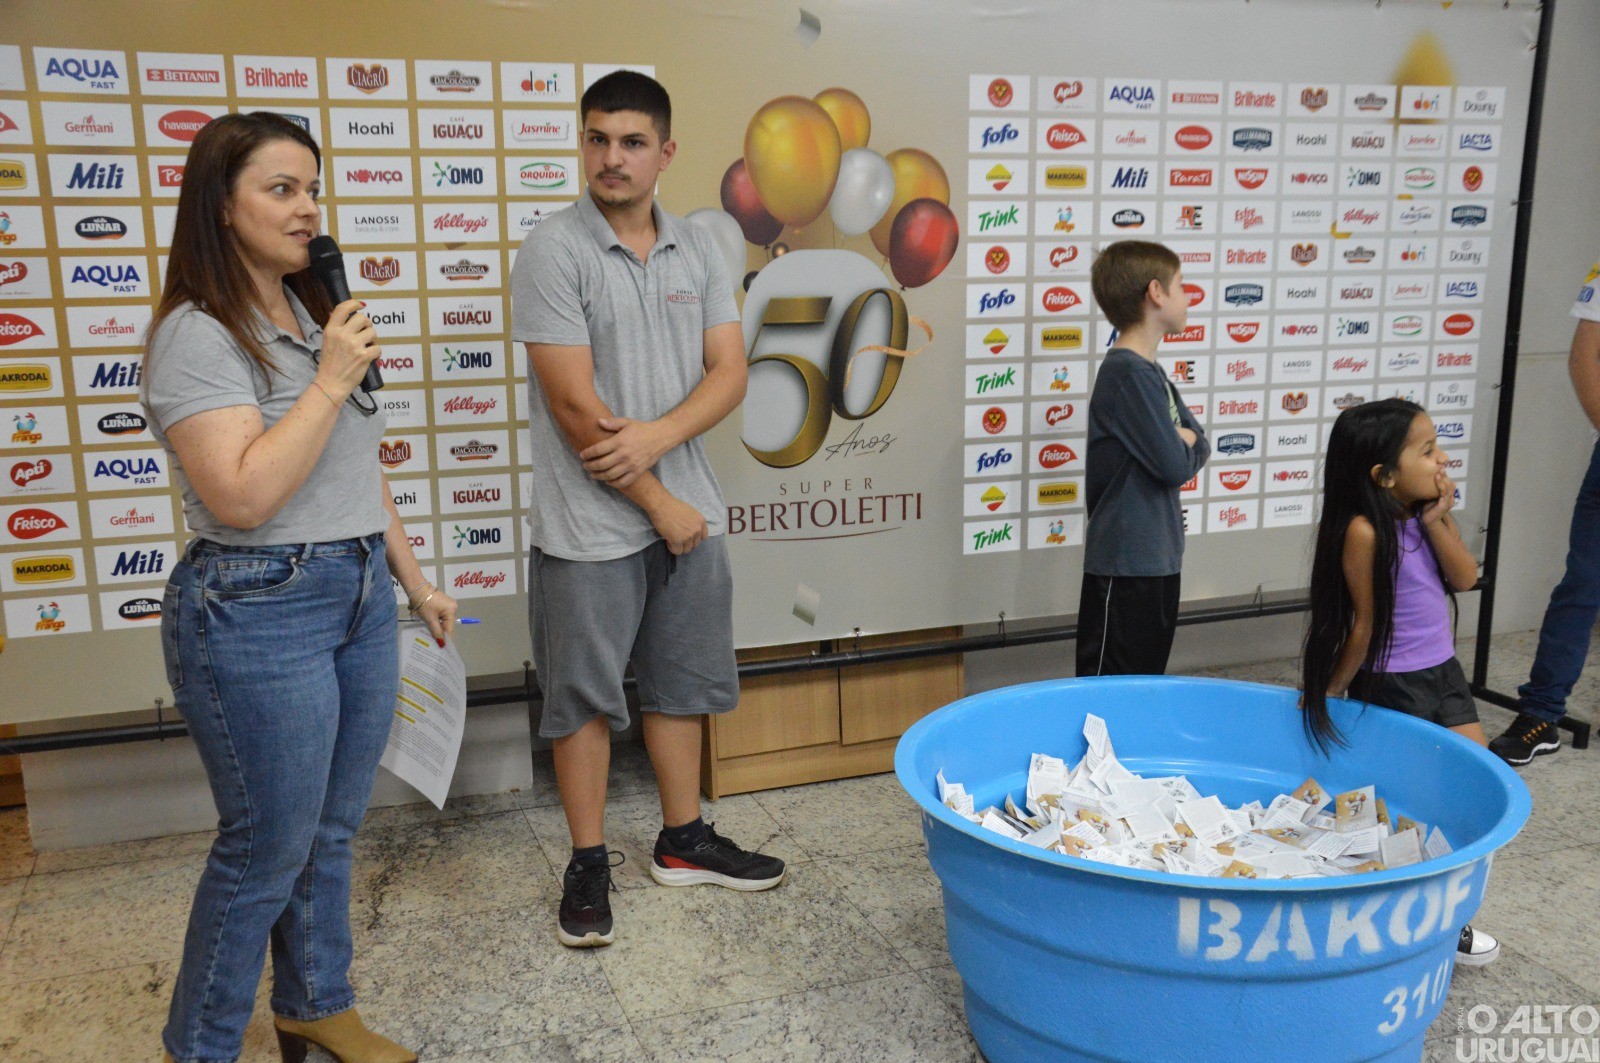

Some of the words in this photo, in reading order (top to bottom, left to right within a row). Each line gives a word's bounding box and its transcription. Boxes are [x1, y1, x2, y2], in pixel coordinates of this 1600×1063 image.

[46, 57, 120, 81] AQUA
[163, 70, 216, 83] BETTANIN
[350, 67, 386, 87] CIAGRO
[244, 67, 308, 88] Brilhante
[521, 70, 558, 92] dori
[1110, 86, 1155, 103] AQUA
[1235, 91, 1276, 108] Brilhante
[65, 122, 114, 134] Germani
[348, 122, 394, 135] Hoahi
[518, 122, 561, 134] Jasmine
[982, 123, 1019, 149] fofo
[1296, 135, 1327, 145] Hoahi
[1459, 133, 1492, 149] LACTA
[66, 162, 124, 189] Mili
[450, 168, 483, 184] OMO
[1111, 167, 1148, 188] Mili
[1358, 172, 1381, 186] OMO
[355, 216, 399, 224] LANOSSI
[434, 213, 488, 232] Kellogg's
[978, 205, 1019, 232] Trink
[1235, 207, 1256, 222] Esfre
[1244, 215, 1263, 230] Bom
[1343, 208, 1380, 225] Kellogg's
[80, 221, 122, 233] LUNAR
[1052, 248, 1073, 263] Apti
[1227, 249, 1266, 264] Brilhante
[0, 264, 20, 282] pti
[71, 265, 141, 286] AQUA
[363, 260, 397, 278] CIAGRO
[1287, 288, 1316, 299] Hoahi
[1446, 282, 1478, 297] LACTA
[979, 288, 1016, 314] fofo
[88, 322, 135, 335] Germani
[1347, 321, 1369, 334] OMO
[1043, 333, 1080, 342] MAKRODAL
[460, 352, 492, 368] OMO
[1227, 360, 1247, 375] Esfre
[1332, 356, 1369, 372] Kellogg's
[0, 373, 48, 381] AKRODAL
[89, 362, 143, 388] Mili
[740, 287, 909, 468] 50
[976, 367, 1016, 394] Trink
[1235, 367, 1255, 381] Bom
[444, 396, 496, 414] Kellogg's
[1219, 400, 1258, 416] Brilhante
[1048, 406, 1069, 422] Apti
[103, 419, 142, 428] LUNAR
[825, 422, 898, 461] Anos
[1278, 435, 1307, 446] Hoahi
[94, 458, 160, 479] AQUA
[977, 448, 1012, 473] fofo
[14, 461, 44, 481] Apti
[1222, 472, 1249, 483] NISSIN
[780, 477, 873, 496] SUPER
[1040, 489, 1076, 497] MAKRODAL
[393, 492, 416, 505] ahi
[110, 513, 155, 526] Germani
[727, 492, 922, 534] BERTOLETTI
[1219, 506, 1240, 521] Esfre
[1228, 514, 1247, 528] Bom
[470, 528, 501, 545] OMO
[973, 523, 1012, 550] Trink
[16, 564, 71, 574] MAKRODAL
[110, 550, 164, 576] Mili
[454, 571, 506, 588] Kellogg's
[124, 603, 161, 614] LUNAR
[1177, 868, 1476, 962] BAKOF
